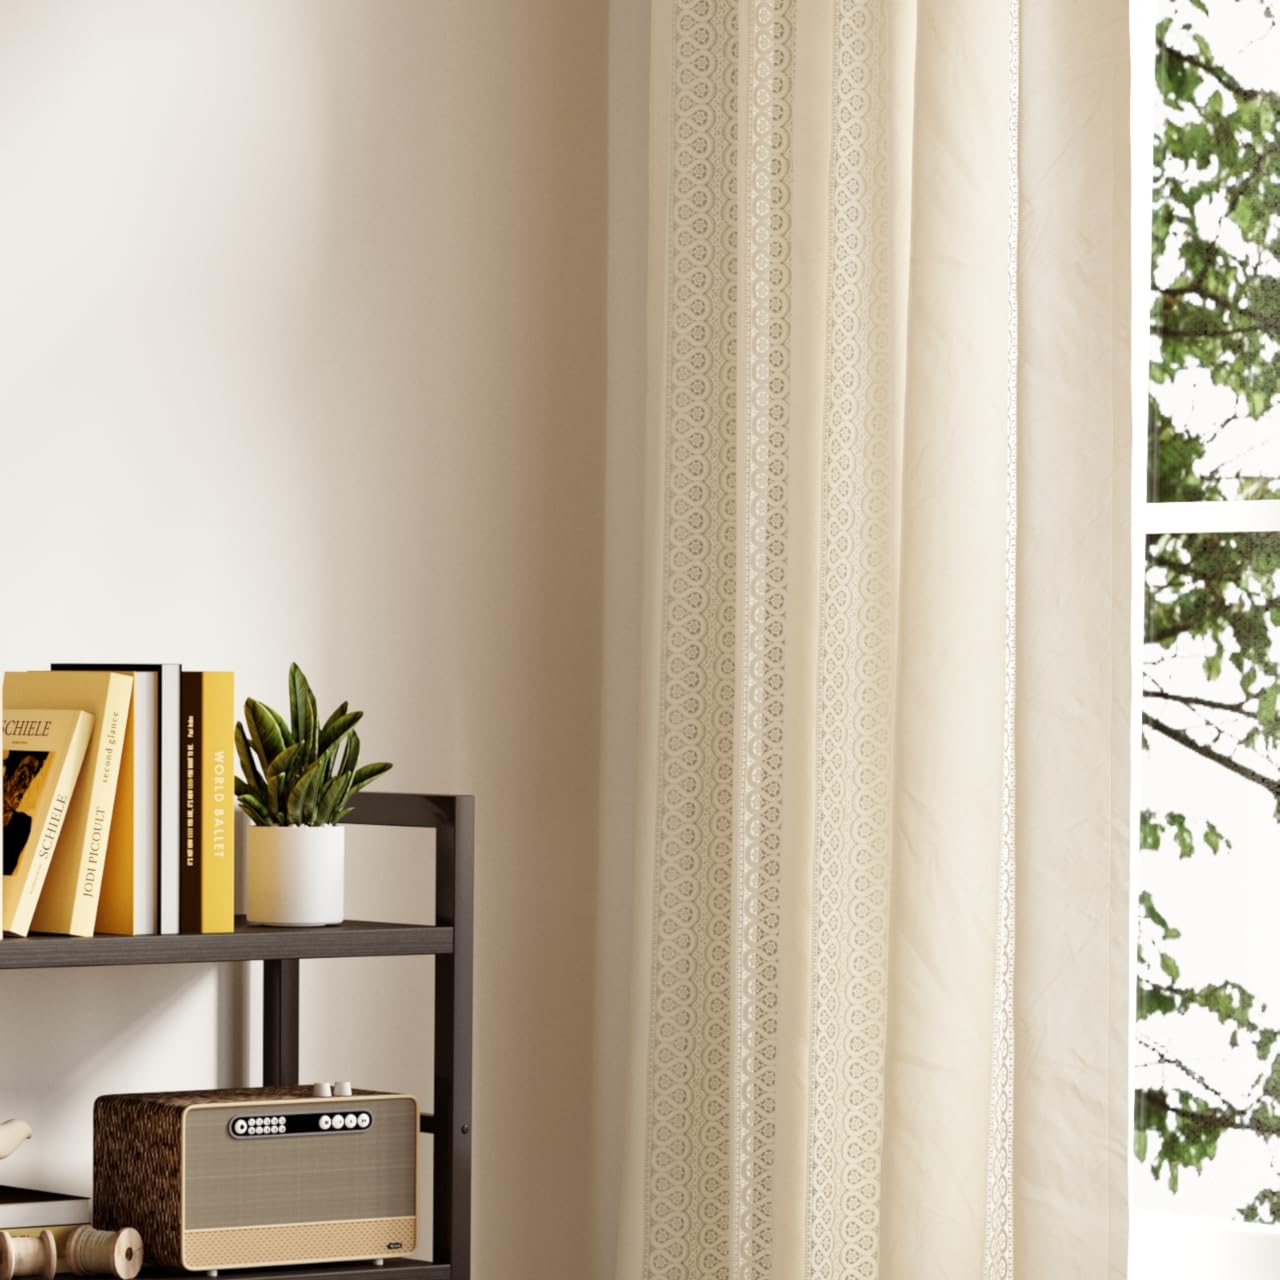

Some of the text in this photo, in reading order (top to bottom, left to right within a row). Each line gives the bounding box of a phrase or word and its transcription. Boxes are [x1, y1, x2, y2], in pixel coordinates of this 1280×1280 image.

[39, 794, 68, 859] SCHIELE
[214, 751, 225, 858] WORLD BALLET
[83, 807, 105, 897] JODI PICOULT
